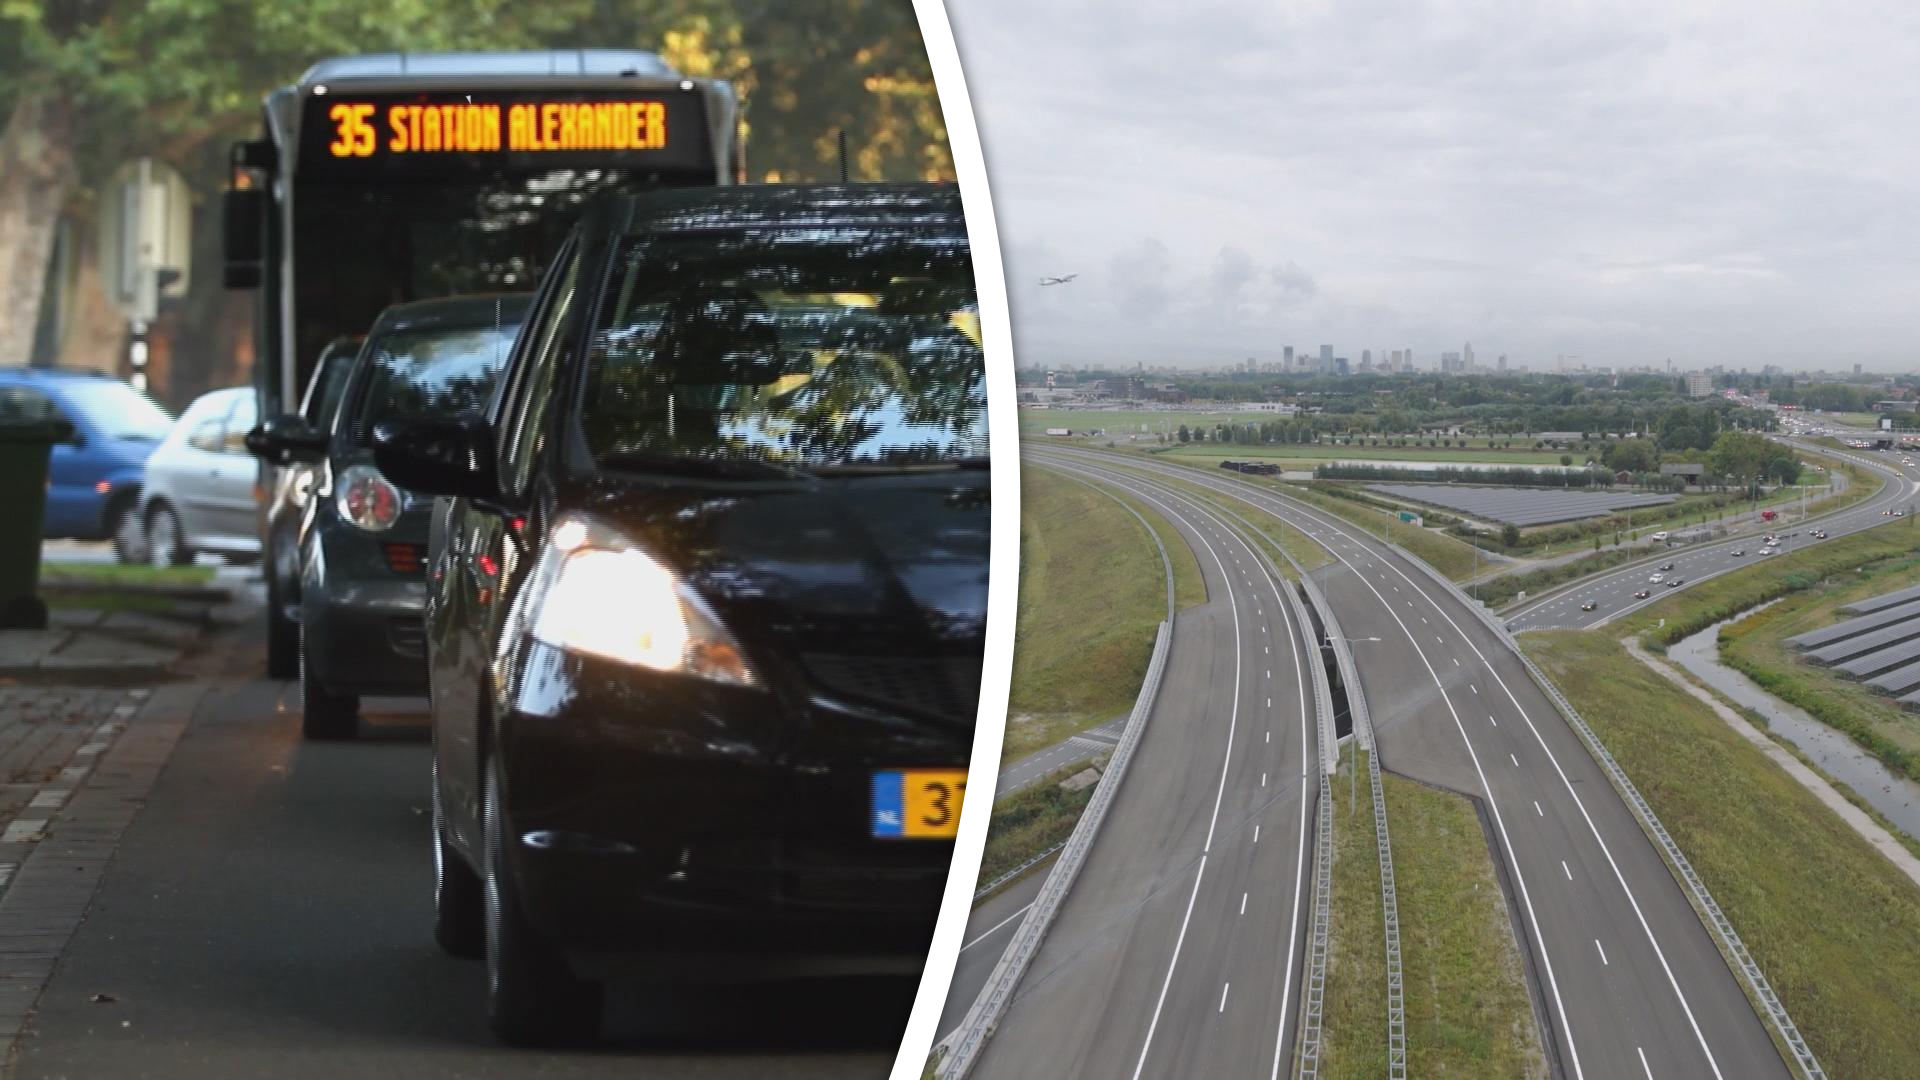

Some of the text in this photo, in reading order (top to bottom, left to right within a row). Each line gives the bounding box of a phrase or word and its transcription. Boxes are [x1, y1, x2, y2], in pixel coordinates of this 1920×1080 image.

[330, 102, 666, 156] 35 STATION ALEXANDER
[922, 780, 966, 827] 3
